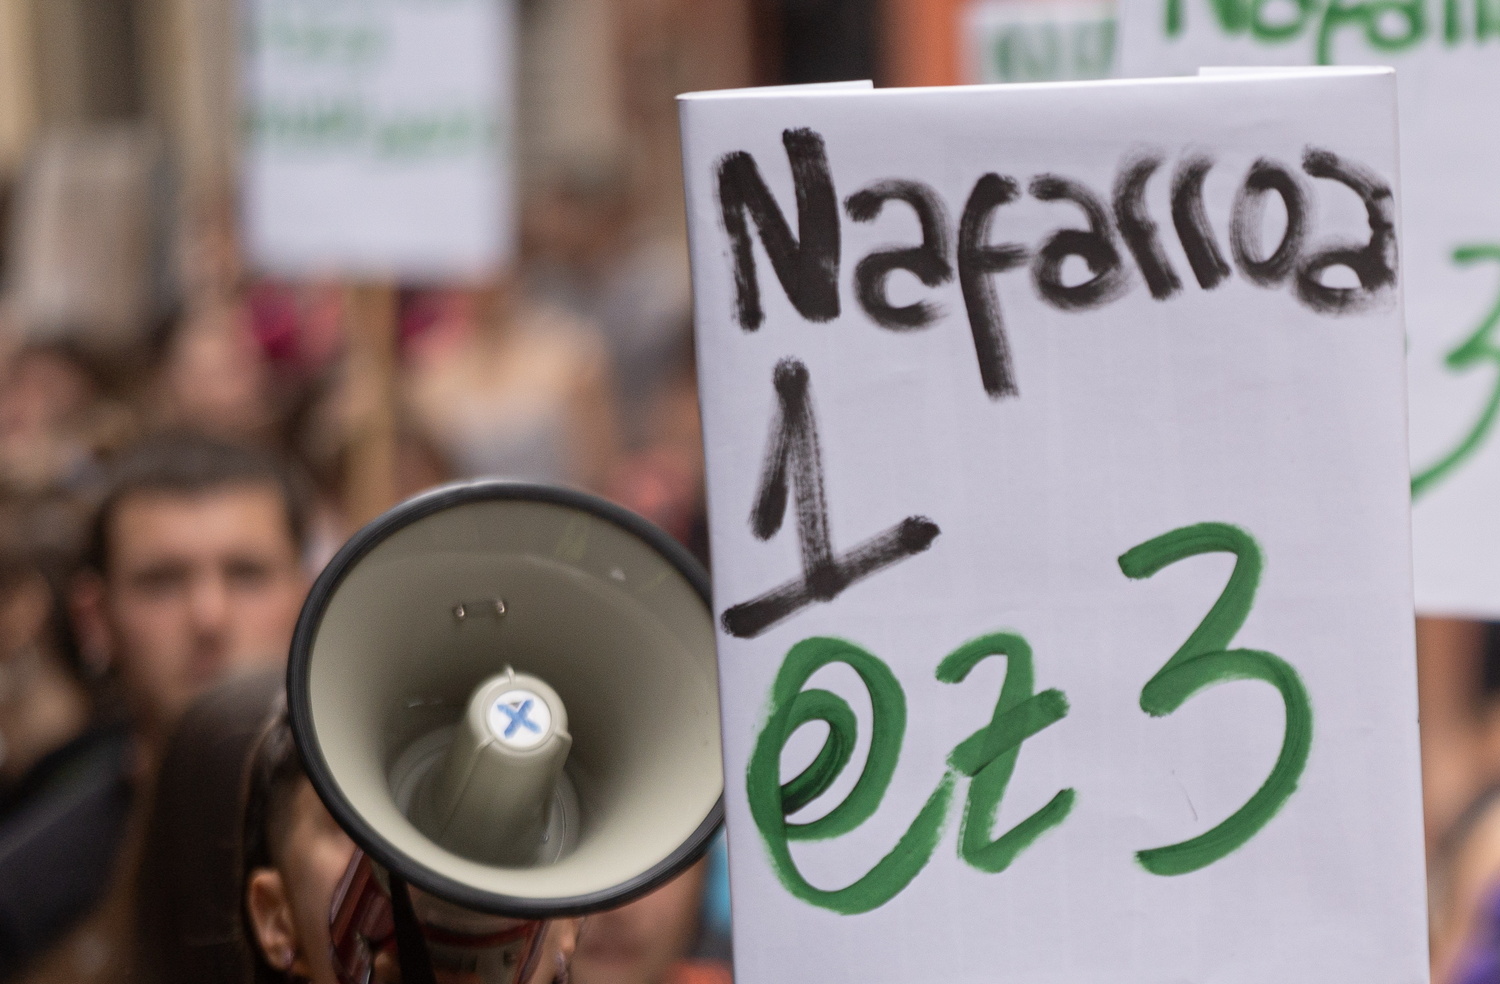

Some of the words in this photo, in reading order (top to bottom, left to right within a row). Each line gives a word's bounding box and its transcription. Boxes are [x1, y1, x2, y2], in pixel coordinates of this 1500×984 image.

[717, 128, 1397, 402] Nafarroa
[718, 358, 942, 641] 1
[747, 633, 1076, 916] ez
[1118, 522, 1315, 877] 3
